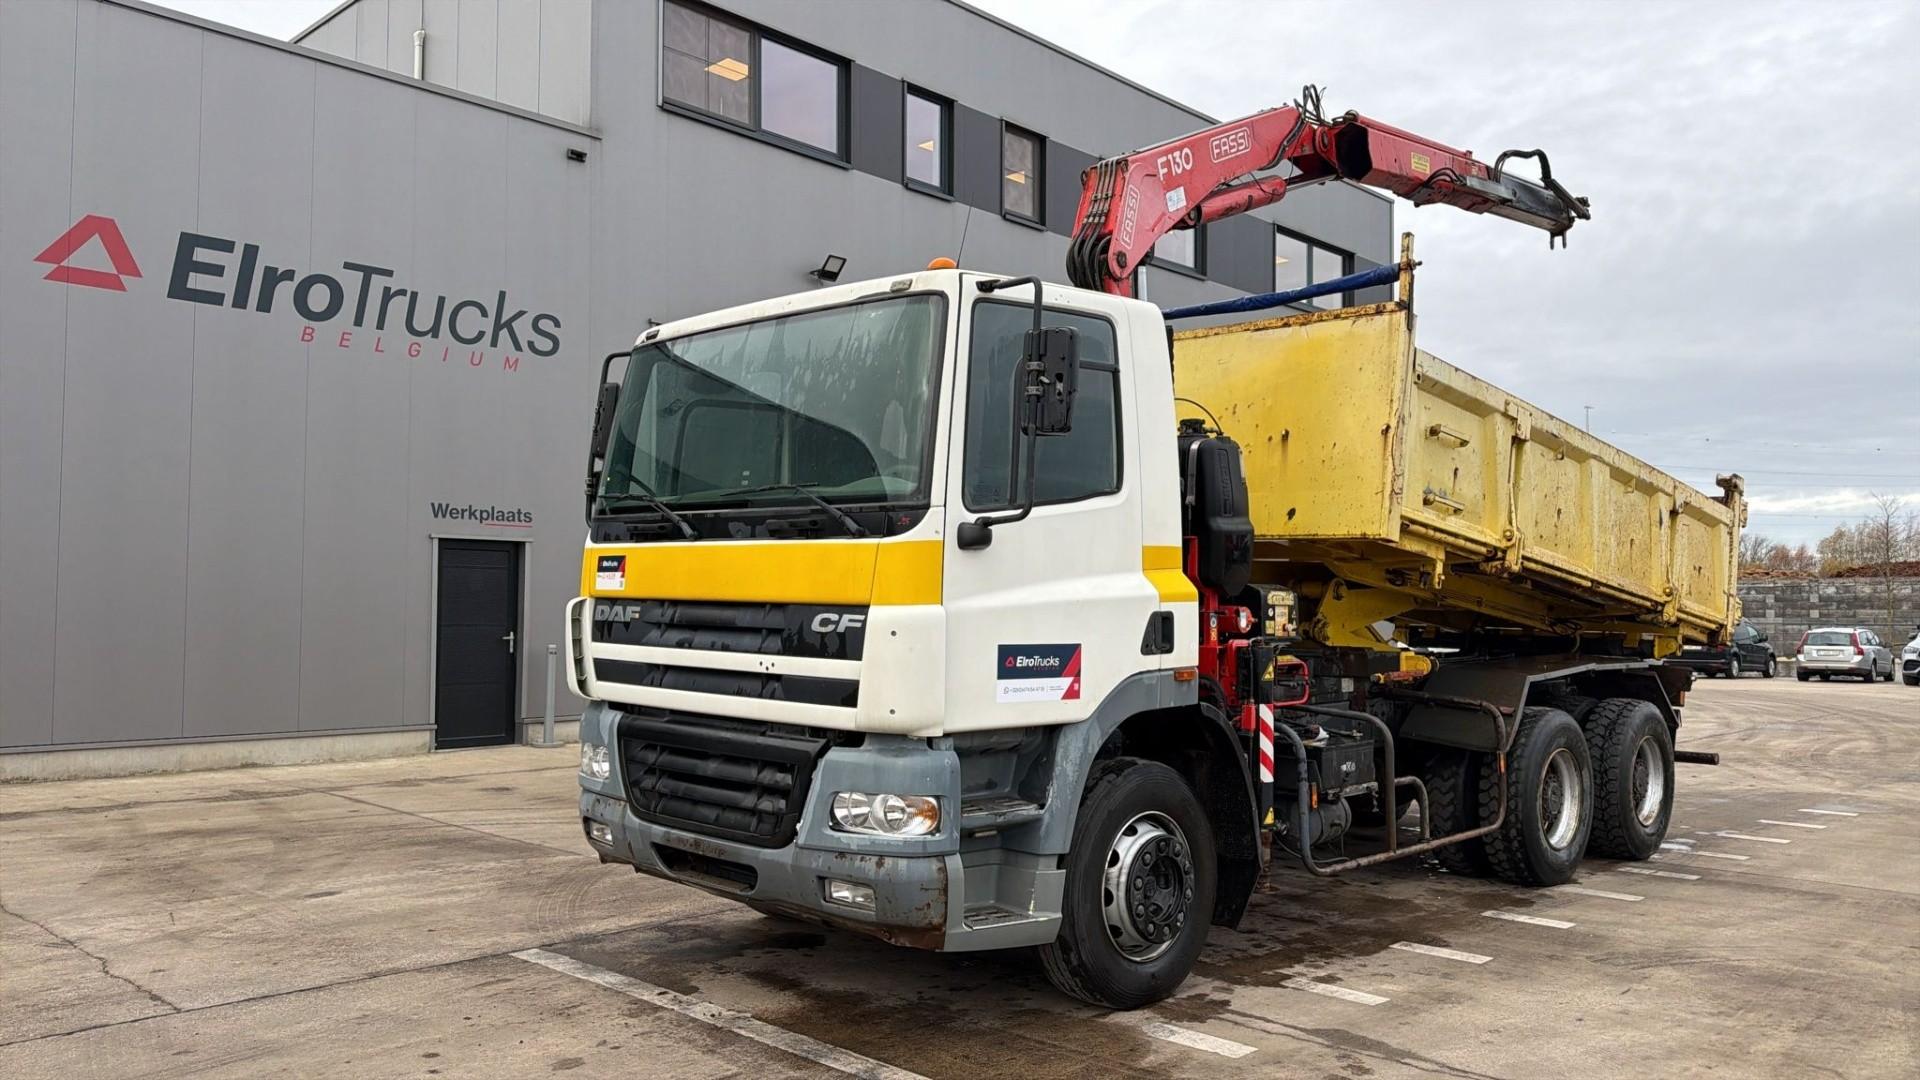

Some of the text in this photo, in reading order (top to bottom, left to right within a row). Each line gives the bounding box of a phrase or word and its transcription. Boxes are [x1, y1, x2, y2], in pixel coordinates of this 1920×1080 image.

[1212, 131, 1249, 160] FASSI
[1123, 188, 1139, 245] FASSI
[166, 231, 562, 357] ElroTrucks
[300, 326, 520, 373] BELGIUM
[430, 502, 533, 526] Werkplaats
[594, 604, 640, 622] DAF
[810, 613, 865, 633] CF
[1016, 656, 1060, 667] ElroTrucks
